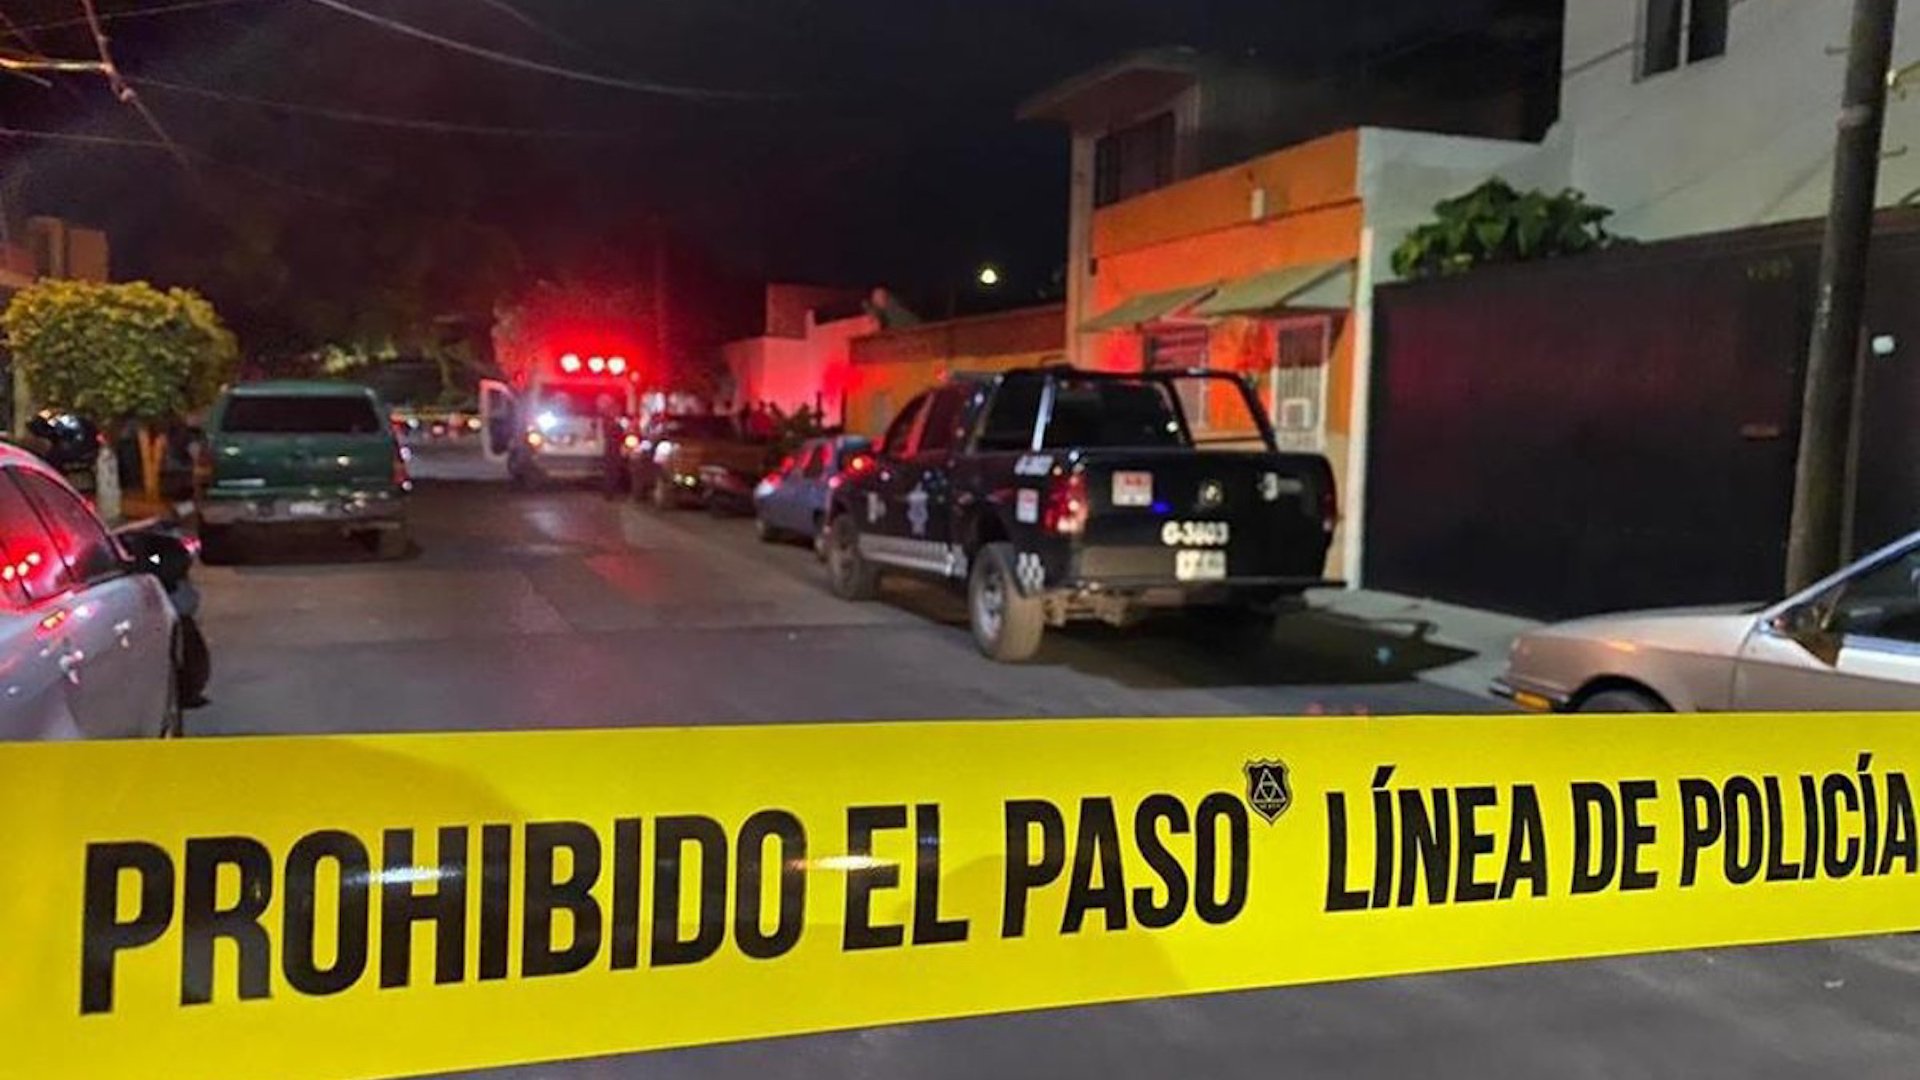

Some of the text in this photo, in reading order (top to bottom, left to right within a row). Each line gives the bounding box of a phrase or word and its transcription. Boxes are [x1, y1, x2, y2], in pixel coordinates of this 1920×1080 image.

[80, 792, 1250, 1015] PROHIBIDO EL PASO
[1325, 752, 1918, 912] LÍNEA DE POLICÍA
